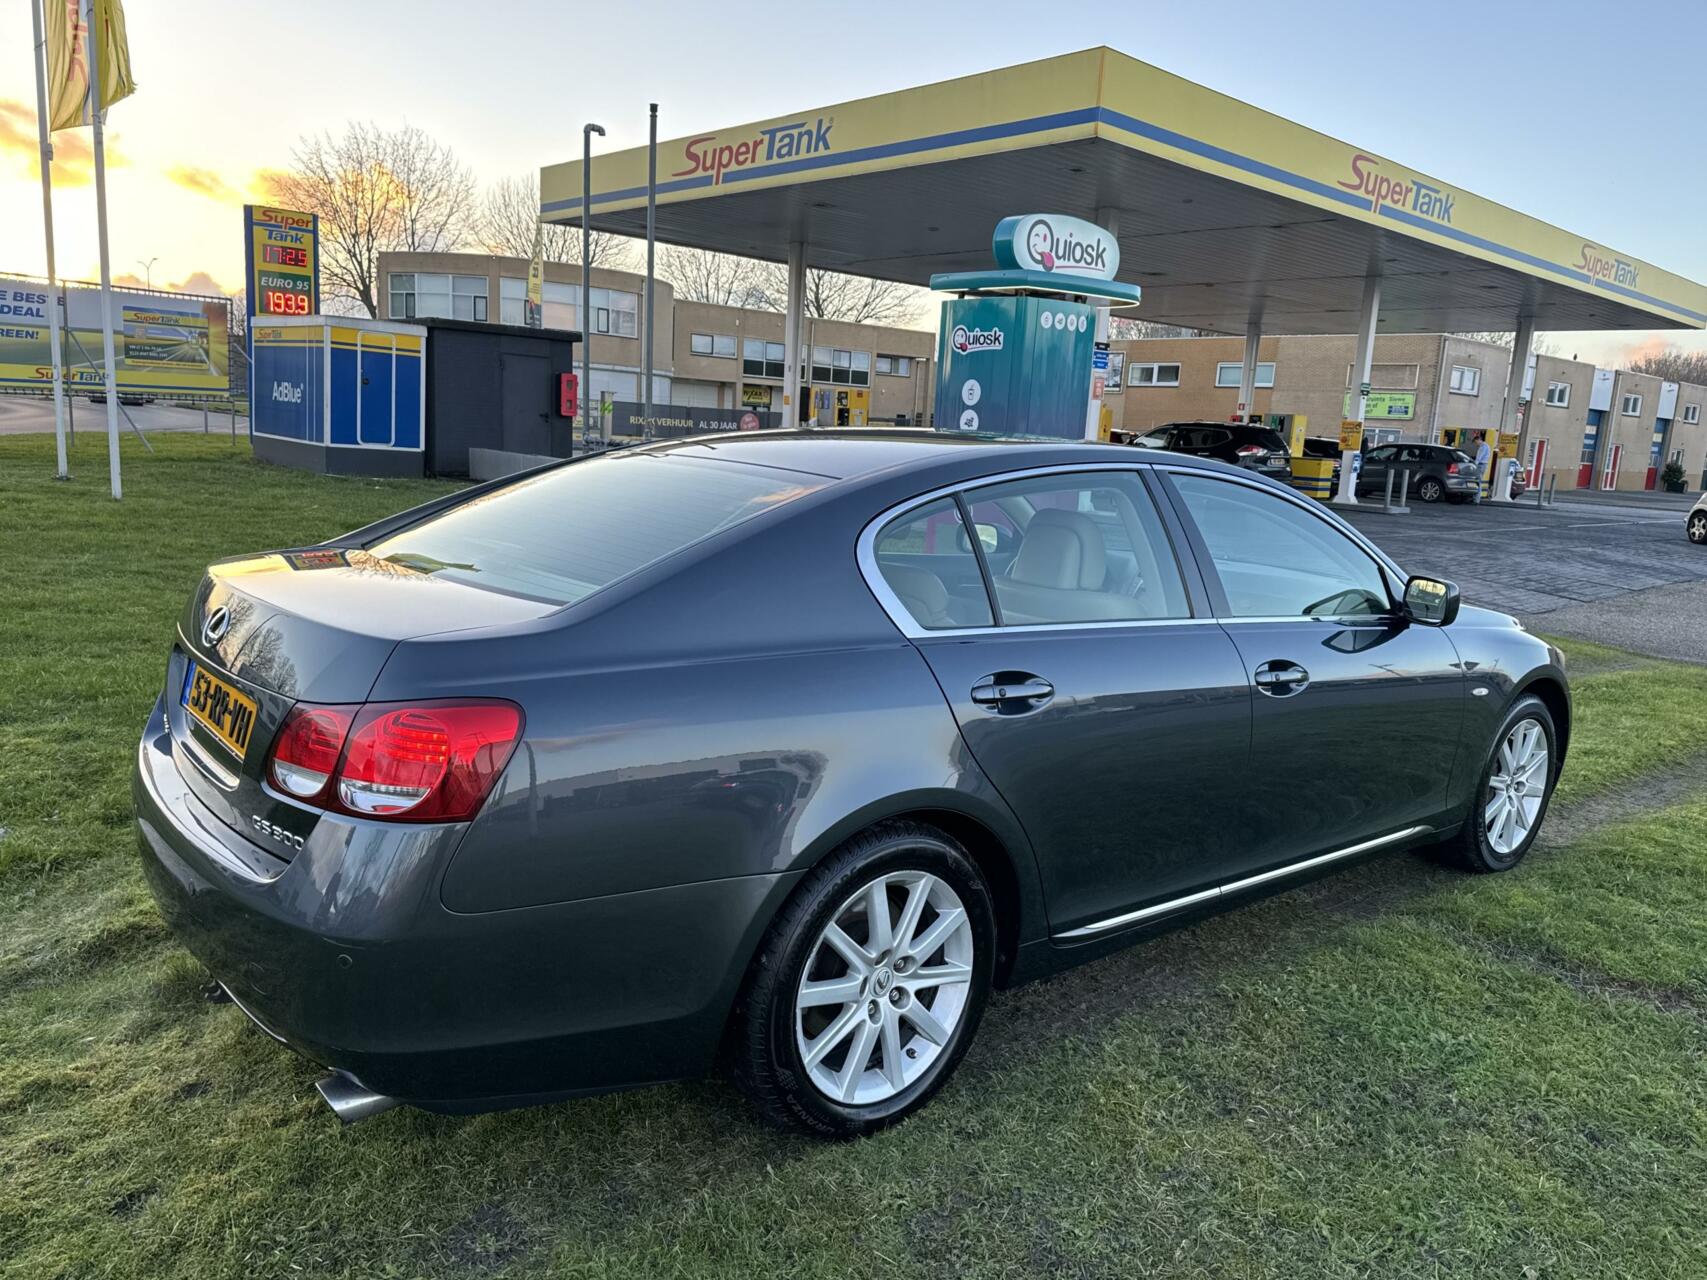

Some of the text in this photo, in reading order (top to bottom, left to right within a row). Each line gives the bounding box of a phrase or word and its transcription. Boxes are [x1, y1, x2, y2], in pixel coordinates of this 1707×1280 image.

[671, 118, 833, 186] SuperTank
[1337, 154, 1455, 223] SuperTank
[254, 209, 312, 230] Super
[263, 228, 304, 244] Tank
[1027, 219, 1107, 272] Quiosk
[265, 246, 307, 266] 17:25
[1572, 243, 1640, 288] SuperTank
[261, 277, 310, 291] EURO 95
[0, 290, 65, 306] E BESE
[0, 304, 45, 318] DEAL
[0, 328, 39, 340] REEN!
[953, 327, 1002, 352] Quiosk
[656, 417, 694, 428] VERHUUR
[699, 420, 708, 429] AL
[709, 420, 719, 430] 30
[719, 421, 738, 430] JAAR
[252, 815, 304, 850] GS300
